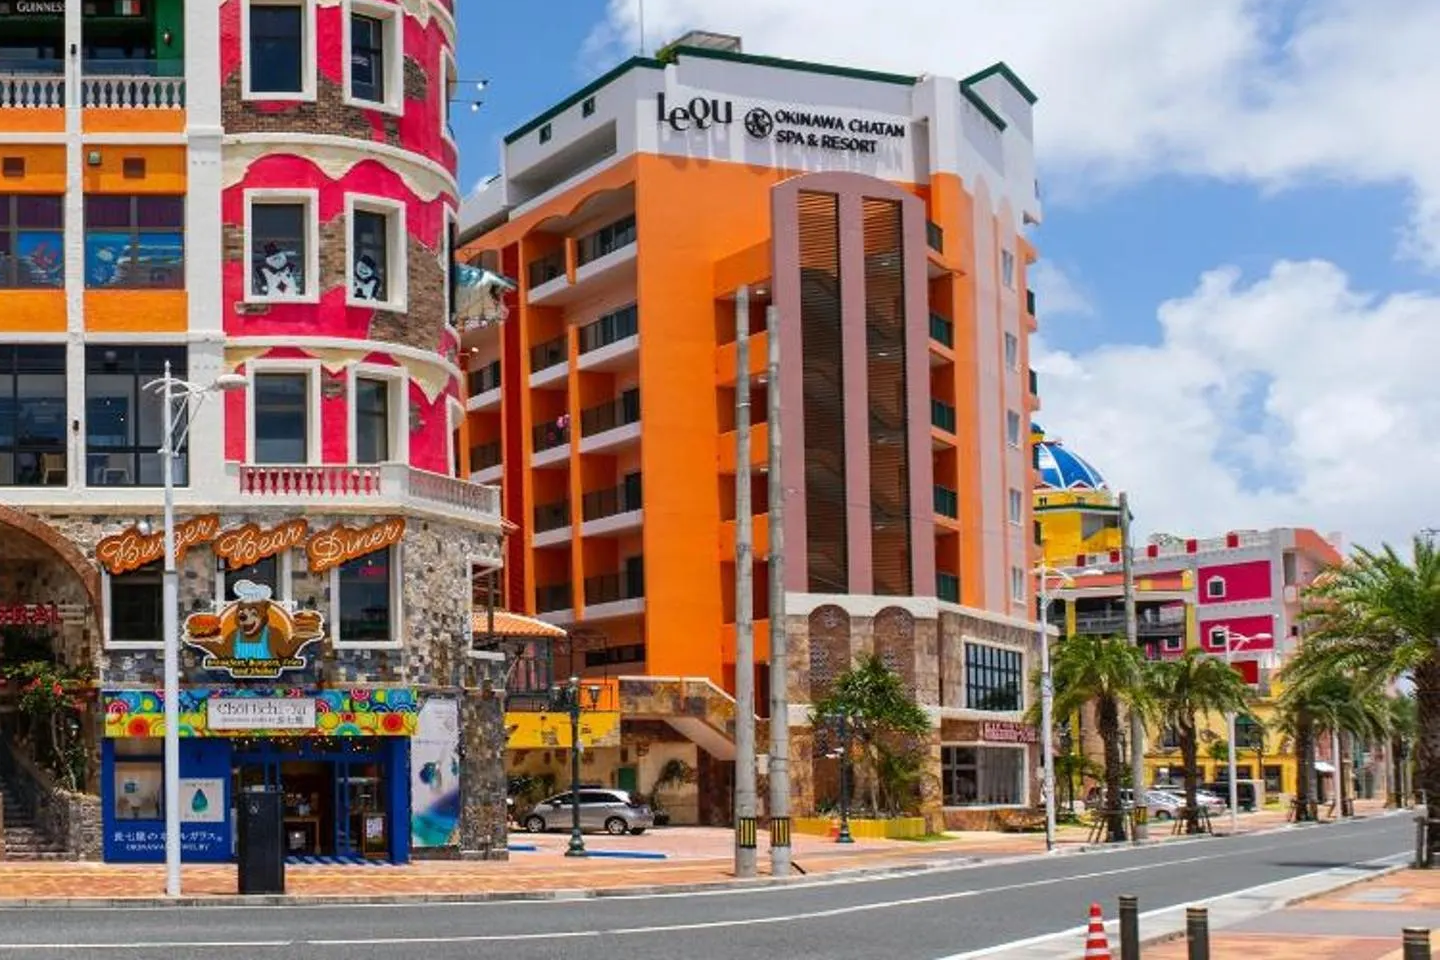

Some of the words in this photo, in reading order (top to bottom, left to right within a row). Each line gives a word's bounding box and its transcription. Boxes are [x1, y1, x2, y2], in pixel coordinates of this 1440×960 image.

[774, 109, 845, 131] OKINAWA
[848, 118, 905, 138] CHATAN
[775, 129, 805, 145] SPA
[805, 133, 820, 147] &
[821, 136, 878, 153] RESORT
[219, 525, 301, 564] Bear
[312, 520, 402, 569] Diner
